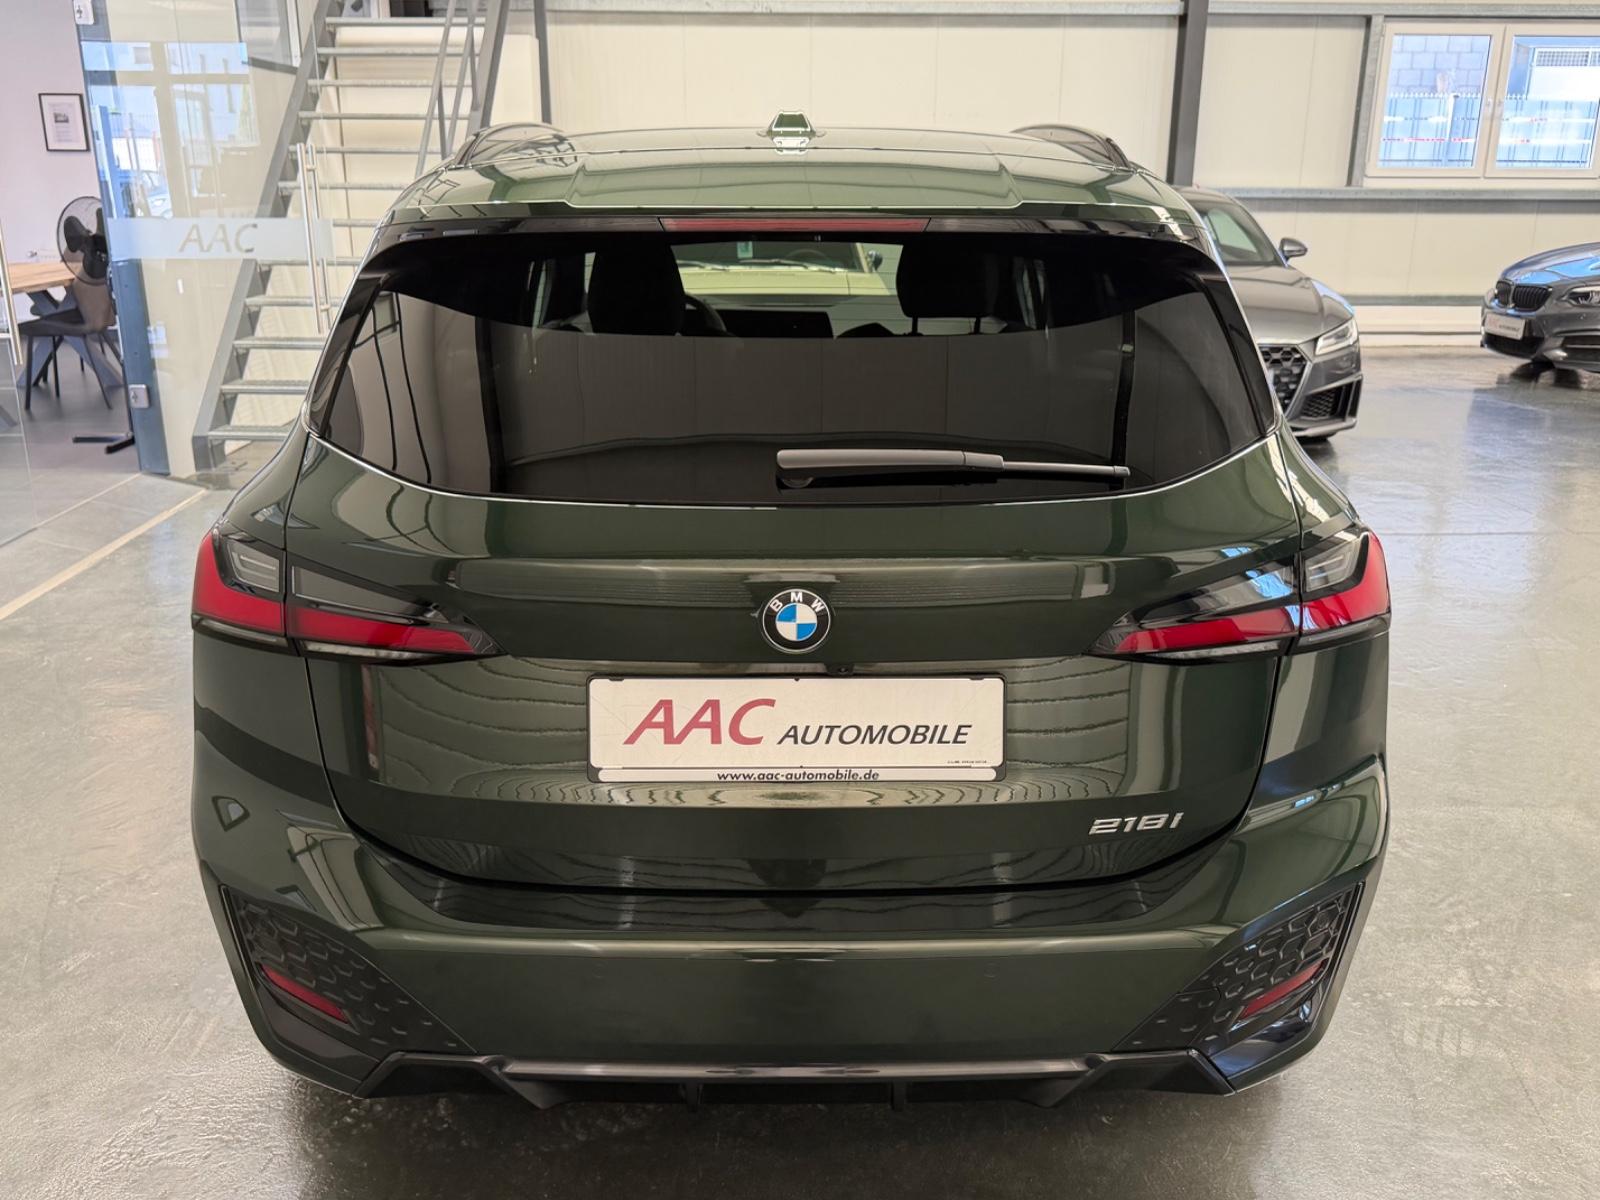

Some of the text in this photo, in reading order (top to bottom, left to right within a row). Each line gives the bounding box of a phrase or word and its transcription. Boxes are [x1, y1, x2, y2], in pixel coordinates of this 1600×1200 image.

[178, 223, 258, 253] AAC
[769, 591, 826, 613] BMW
[622, 698, 972, 746] AAC AUTOMOBILE
[717, 769, 880, 782] www.aac-automobile.de
